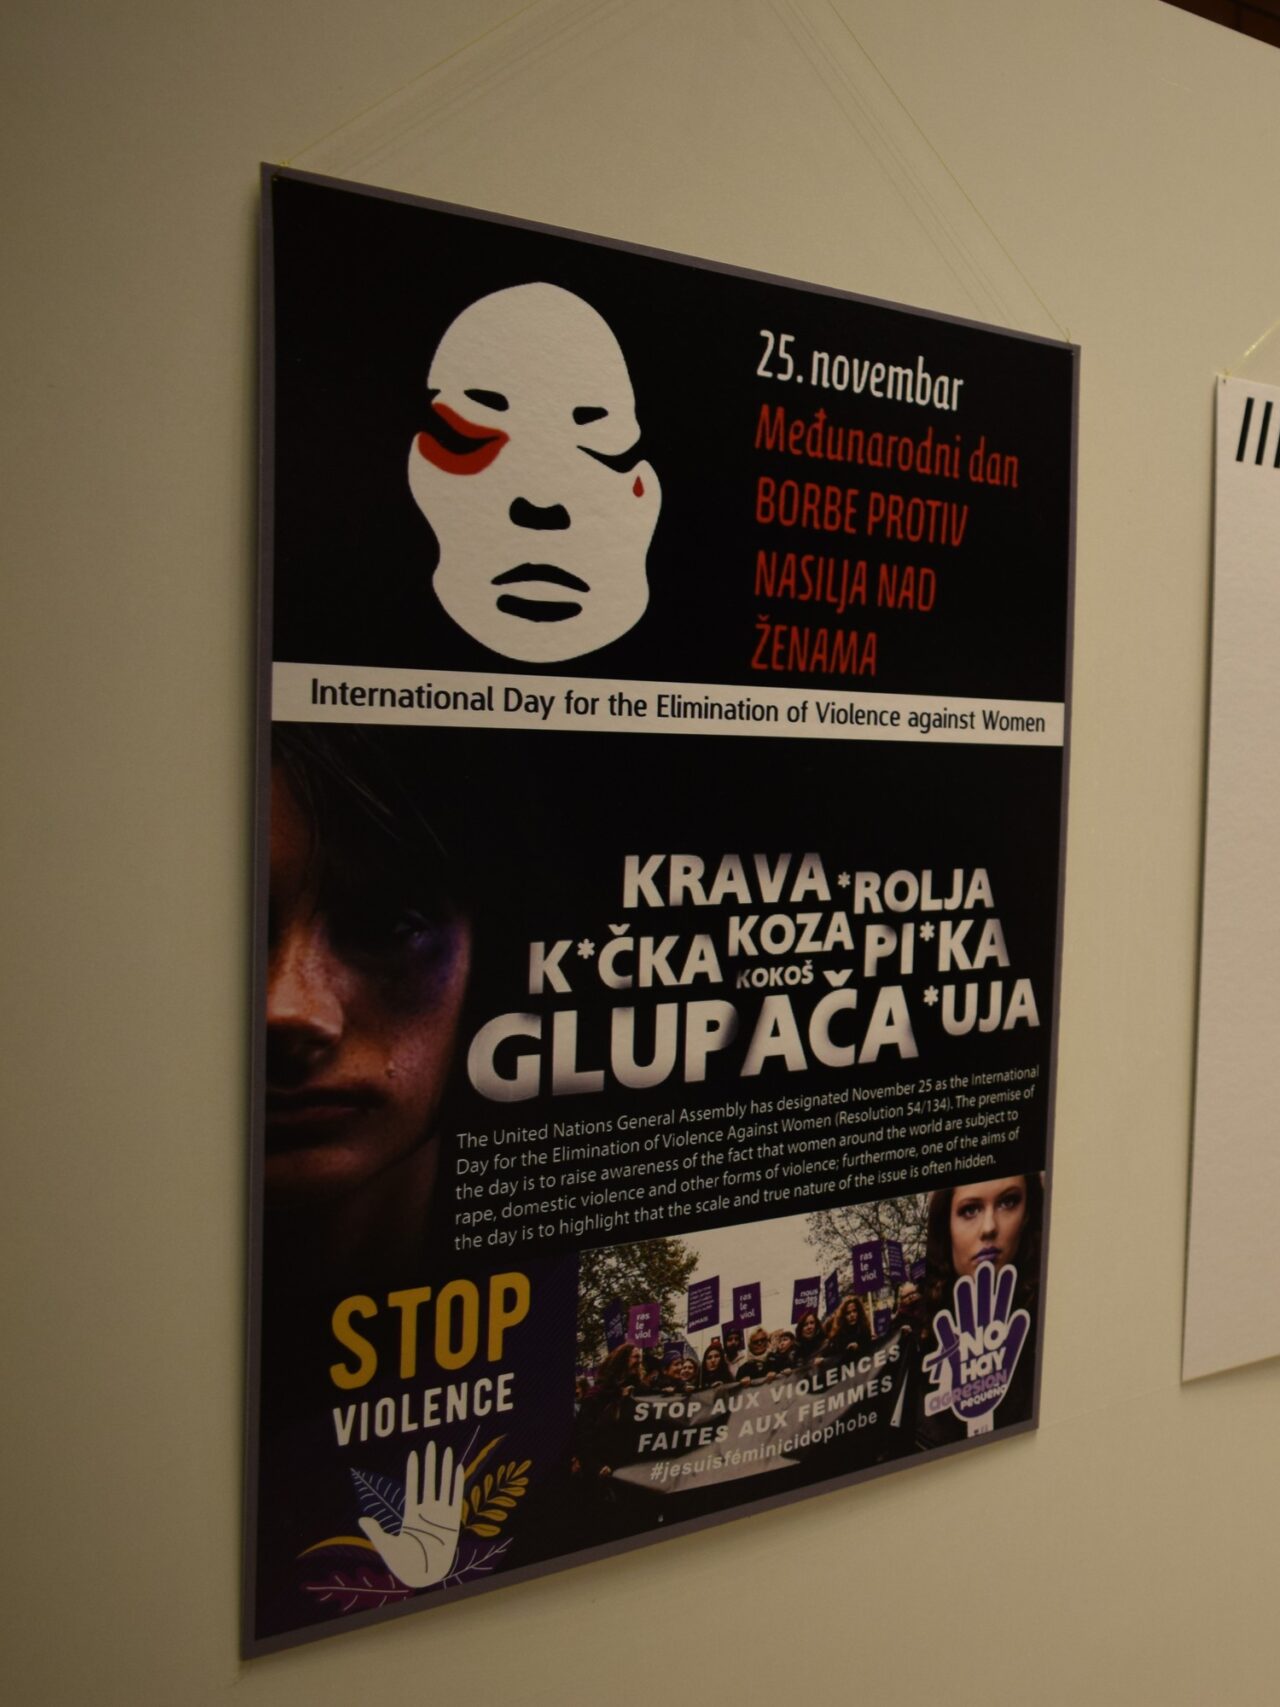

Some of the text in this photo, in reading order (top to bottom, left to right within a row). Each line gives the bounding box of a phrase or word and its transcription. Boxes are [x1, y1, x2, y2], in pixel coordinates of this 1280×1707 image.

[756, 330, 964, 412] 25. novembar
[755, 404, 1019, 488] Međunarodni dan
[755, 476, 968, 547] BORBE PROTIV
[754, 550, 936, 614] NASILJA NAD
[751, 613, 877, 677] ŽENAMA
[312, 678, 1046, 734] International Day for the Elimination of Violence against Women
[623, 852, 832, 908] KRAVA
[728, 911, 855, 957] KOZA
[736, 959, 814, 989] KOKOŠ
[467, 969, 919, 1103] GLUPAČA
[456, 1157, 489, 1176] Day
[493, 1152, 517, 1169] for
[521, 1149, 548, 1166] the
[553, 1140, 640, 1162] Elimination
[644, 1133, 659, 1151] of
[662, 1129, 724, 1148] Violence
[727, 1121, 779, 1142] Against
[781, 1115, 832, 1132] Women
[956, 1094, 976, 1108] The
[979, 1090, 1021, 1109] premise
[1023, 1084, 1035, 1099] of
[457, 1064, 1039, 1148] The United Nations General Assembly has designated November 25 as the International
[455, 1109, 1019, 1200] the day is to raise awareness of the fact that women around the world are subject to
[455, 1208, 497, 1226] rape,
[501, 1195, 577, 1218] domestic
[580, 1186, 645, 1206] violence
[648, 1178, 677, 1197] and
[680, 1175, 720, 1192] other
[722, 1169, 762, 1185] forms
[765, 1162, 779, 1179] of
[842, 1146, 918, 1167] furthermore,
[921, 1141, 944, 1155] one
[945, 1135, 958, 1151] of
[959, 1136, 979, 1149] the
[980, 1131, 1006, 1145] aims
[1008, 1125, 1019, 1141] of
[454, 1153, 996, 1250] the day is to highlight that the scale and true nature of the issue is often hidden.
[330, 1272, 531, 1390] STOP
[960, 1320, 1008, 1361] NO
[332, 1372, 515, 1447] VIOLENCE
[633, 1344, 900, 1422] STOP AUX VIOLENCES
[638, 1375, 893, 1453] FAITES AUX FEMMES
